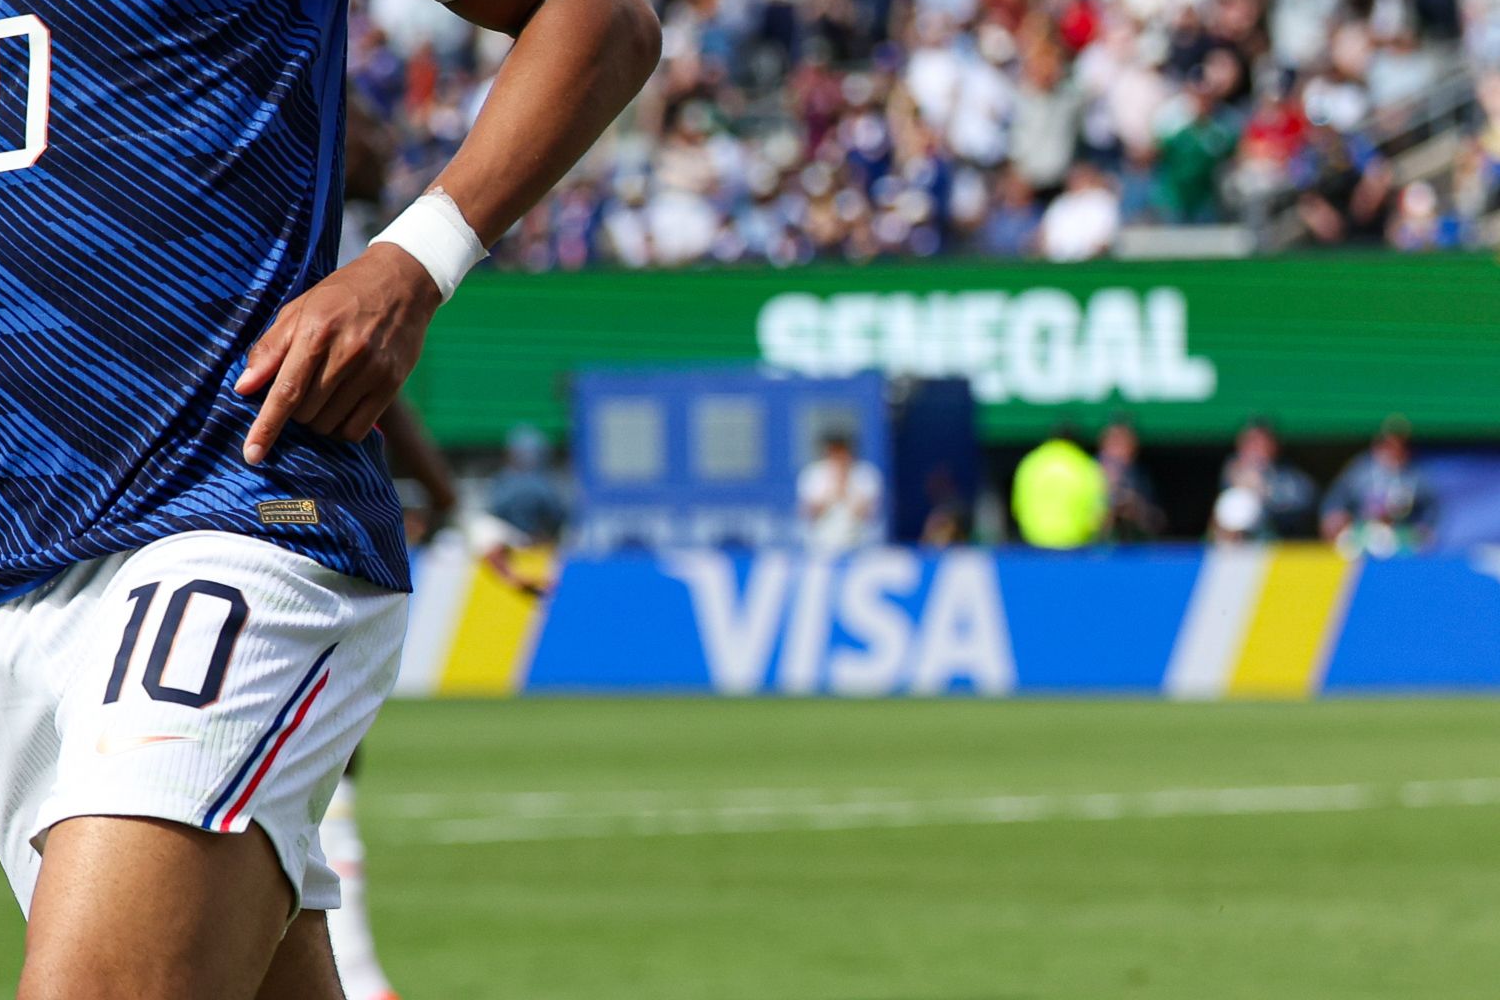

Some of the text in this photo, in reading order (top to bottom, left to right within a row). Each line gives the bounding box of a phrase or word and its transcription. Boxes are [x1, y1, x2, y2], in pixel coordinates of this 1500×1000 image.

[756, 286, 1218, 404] SENEGAL
[102, 579, 251, 709] 10
[652, 547, 1022, 698] VISA
